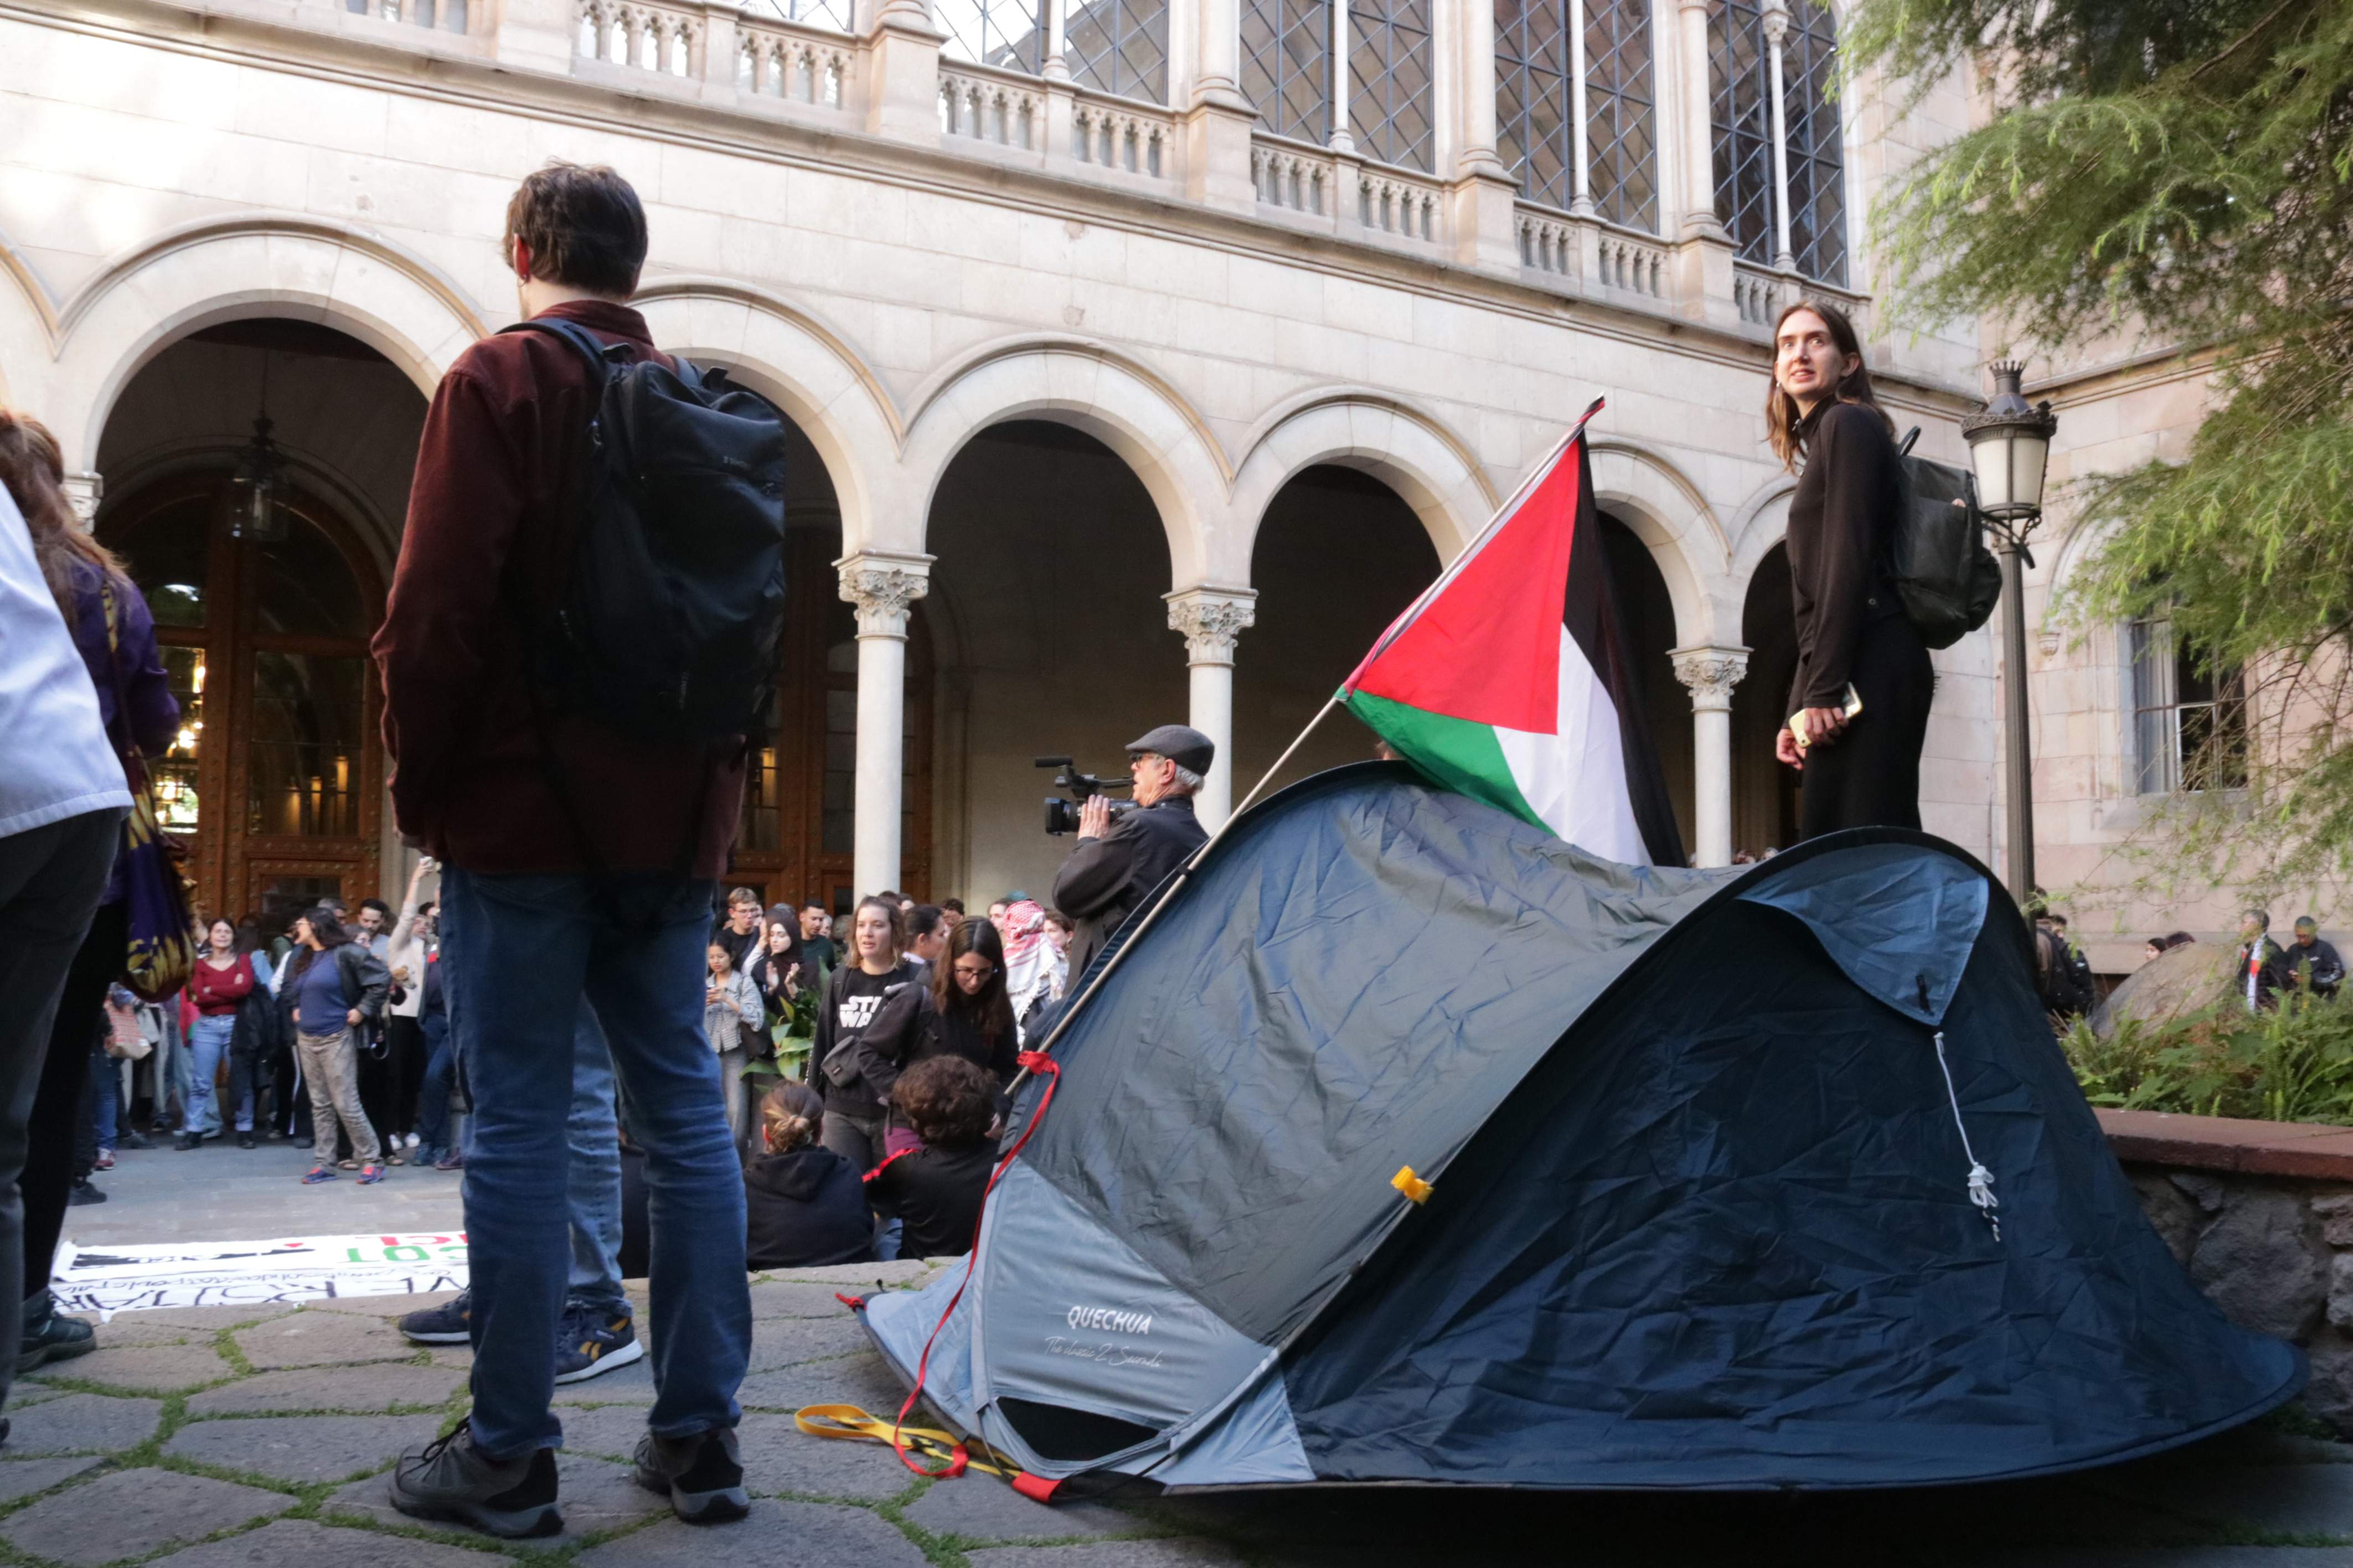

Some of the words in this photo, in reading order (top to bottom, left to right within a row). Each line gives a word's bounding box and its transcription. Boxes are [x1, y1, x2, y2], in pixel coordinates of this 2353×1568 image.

[1067, 1306, 1152, 1335] QUECHUA
[1044, 1336, 1066, 1355] The
[1095, 1343, 1113, 1362] 2
[1108, 1346, 1163, 1368] Seconds
